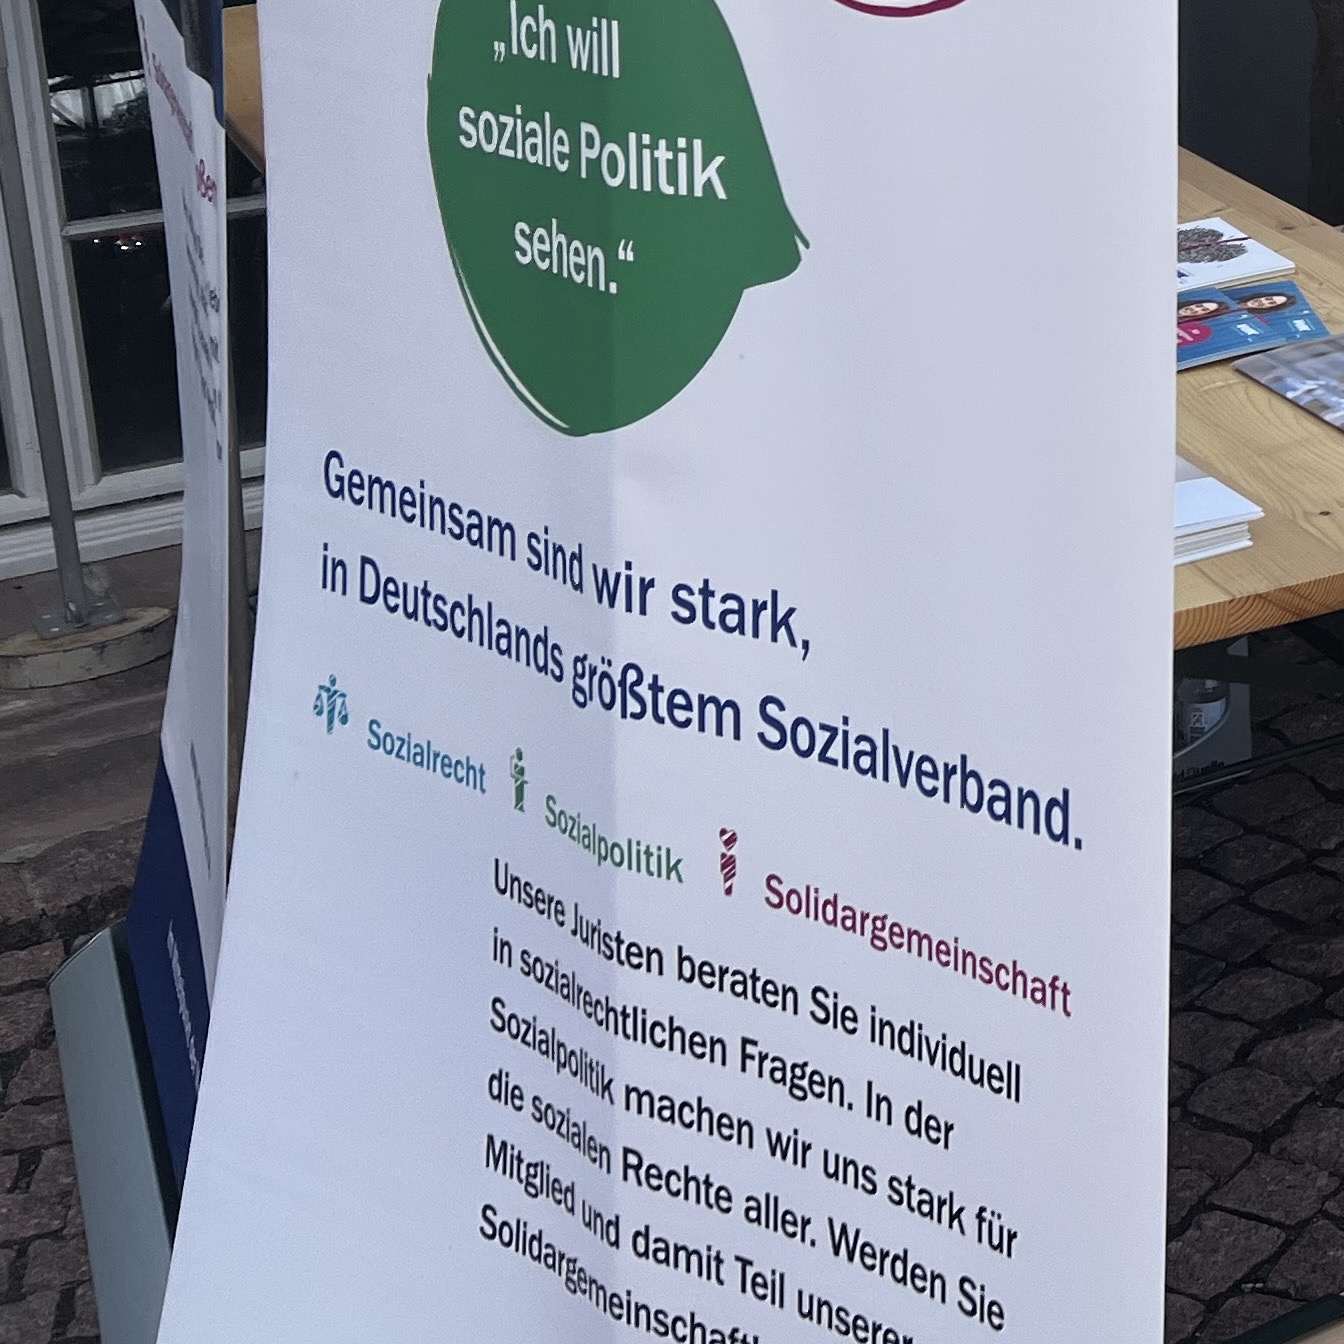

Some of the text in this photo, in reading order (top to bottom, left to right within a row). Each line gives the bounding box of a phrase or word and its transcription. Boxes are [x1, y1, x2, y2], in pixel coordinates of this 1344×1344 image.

[493, 0, 620, 79] „Ich will
[458, 104, 728, 202] soziale Politik
[513, 218, 635, 295] sehen.“
[323, 450, 812, 660] Gemeinsam sind wir stark,
[321, 543, 1084, 852] in Deutschlands größtem Sozialverband.
[367, 718, 488, 795] Sozialrecht
[544, 793, 685, 885] Sozialpolitik
[493, 858, 1022, 1104] Unsere Juristen beraten Sie individuell
[764, 872, 1073, 1018] Solidargemeinschaft
[492, 927, 955, 1151] in sozialrechtlichen Fragen. In der
[487, 1068, 1006, 1333] die sozialen Rechte aller. Werden Sie
[489, 997, 1019, 1260] Sozialpolitik machen wir uns stark für
[485, 1133, 576, 1216] Mitglied
[581, 1199, 621, 1249] und
[631, 1223, 726, 1287] damit
[734, 1255, 785, 1310] Teil
